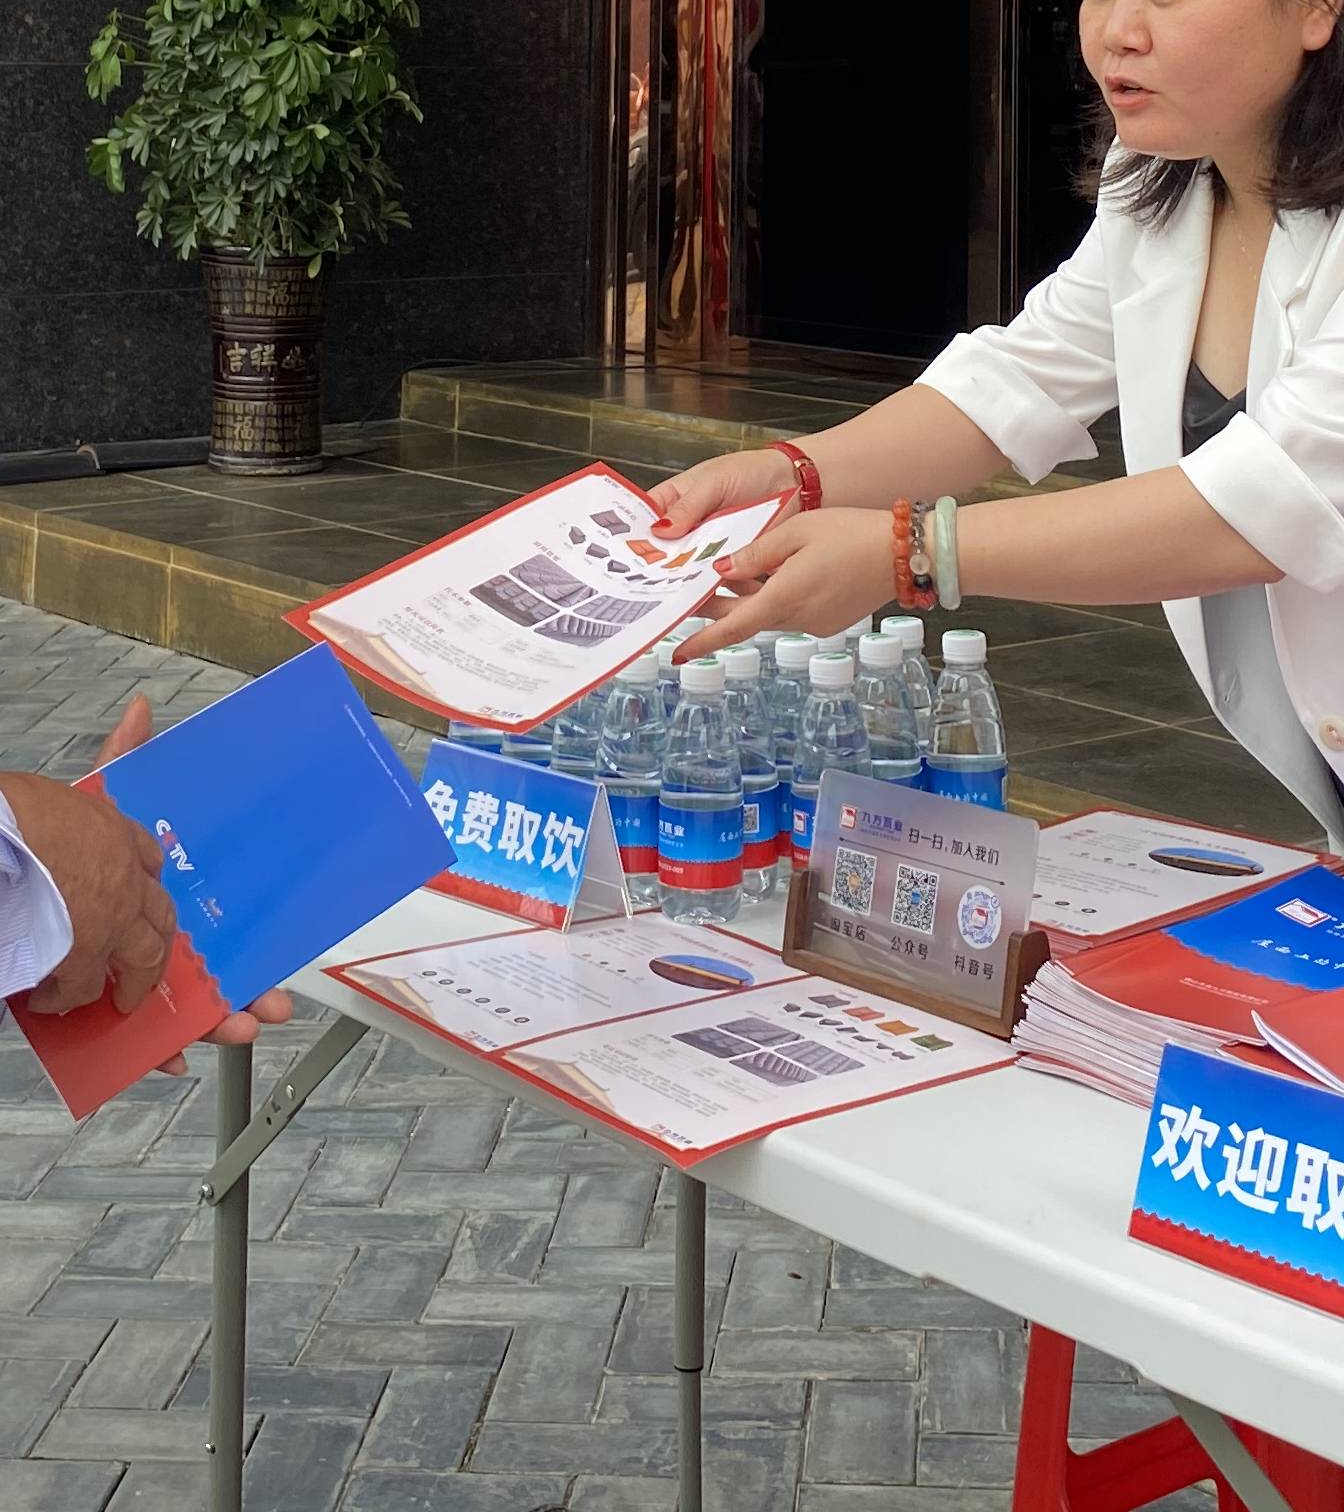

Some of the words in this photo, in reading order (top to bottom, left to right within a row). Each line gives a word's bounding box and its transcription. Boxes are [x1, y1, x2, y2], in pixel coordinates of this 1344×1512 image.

[424, 779, 585, 878] 免费取饮
[890, 936, 929, 961] 公众号
[954, 954, 994, 980] 抖音号
